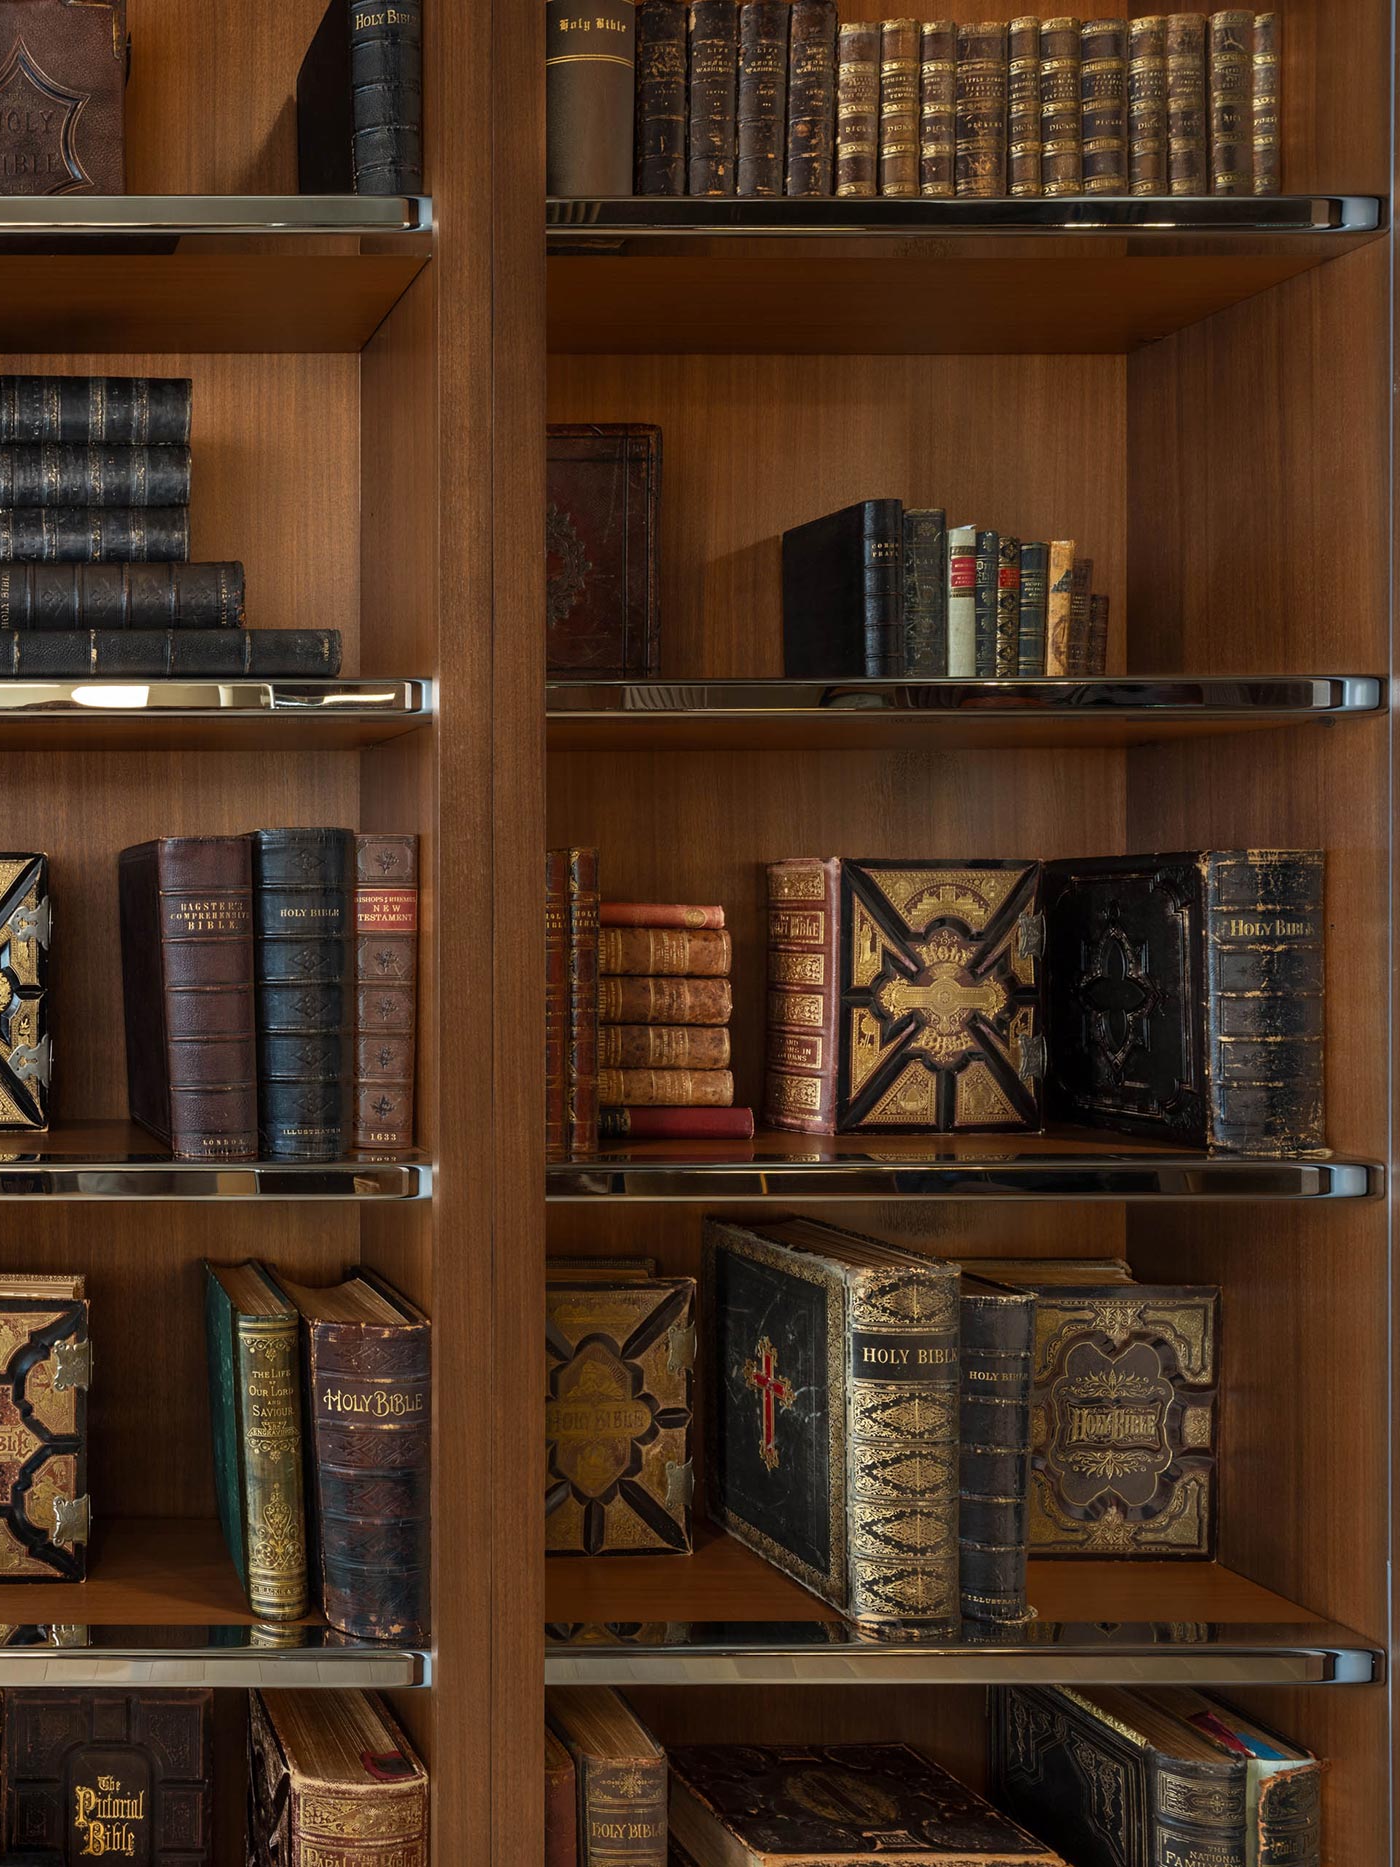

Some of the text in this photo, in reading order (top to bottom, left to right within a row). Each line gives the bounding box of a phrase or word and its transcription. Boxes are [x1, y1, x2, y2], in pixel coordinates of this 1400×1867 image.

[355, 13, 384, 31] HOLY
[559, 17, 627, 34] Holy Bible
[181, 902, 243, 912] BAGSTER'S
[280, 908, 340, 918] HOLY BIBLE
[373, 904, 401, 912] NEW
[358, 913, 413, 922] TESTAMENT
[1230, 920, 1274, 937] HOLY
[370, 1133, 397, 1142] 1633
[863, 1346, 909, 1365] HOLY
[252, 1369, 291, 1379] THE LIFE
[968, 1370, 998, 1382] HOLY
[248, 1386, 294, 1397] OUR LORD
[252, 1404, 294, 1417] SAVIOUR
[323, 1389, 424, 1417] HOLY BIBLE
[1071, 1408, 1156, 1442] HOLY BIBLE
[97, 1775, 121, 1792] The
[74, 1785, 145, 1828] Pictorial
[591, 1822, 667, 1839] HOLY BIBLE
[80, 1820, 136, 1857] Bible
[1189, 1851, 1241, 1863] NATIONAL
